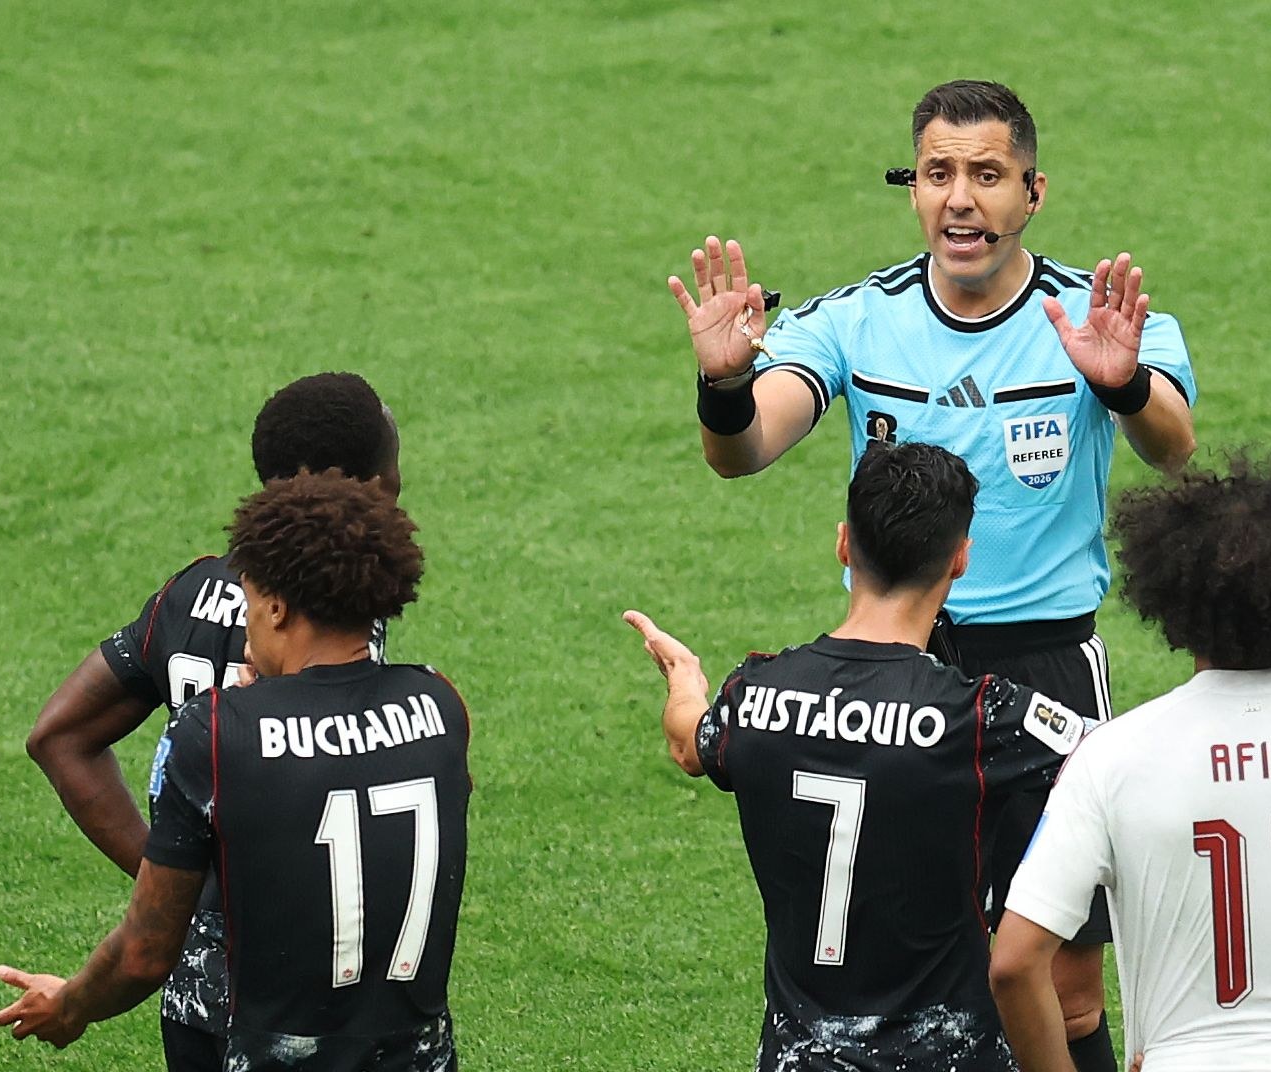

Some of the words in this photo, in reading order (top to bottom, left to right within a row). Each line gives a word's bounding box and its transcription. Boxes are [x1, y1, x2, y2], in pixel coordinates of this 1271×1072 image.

[1011, 419, 1062, 442] FIFA
[1013, 448, 1064, 463] REFEREE
[1028, 474, 1052, 485] 2026
[190, 578, 247, 628] LAR
[259, 693, 446, 759] BUCHANAN
[736, 685, 946, 748] EUSTÁQUIO
[314, 776, 441, 988] 17
[792, 770, 867, 966] 7
